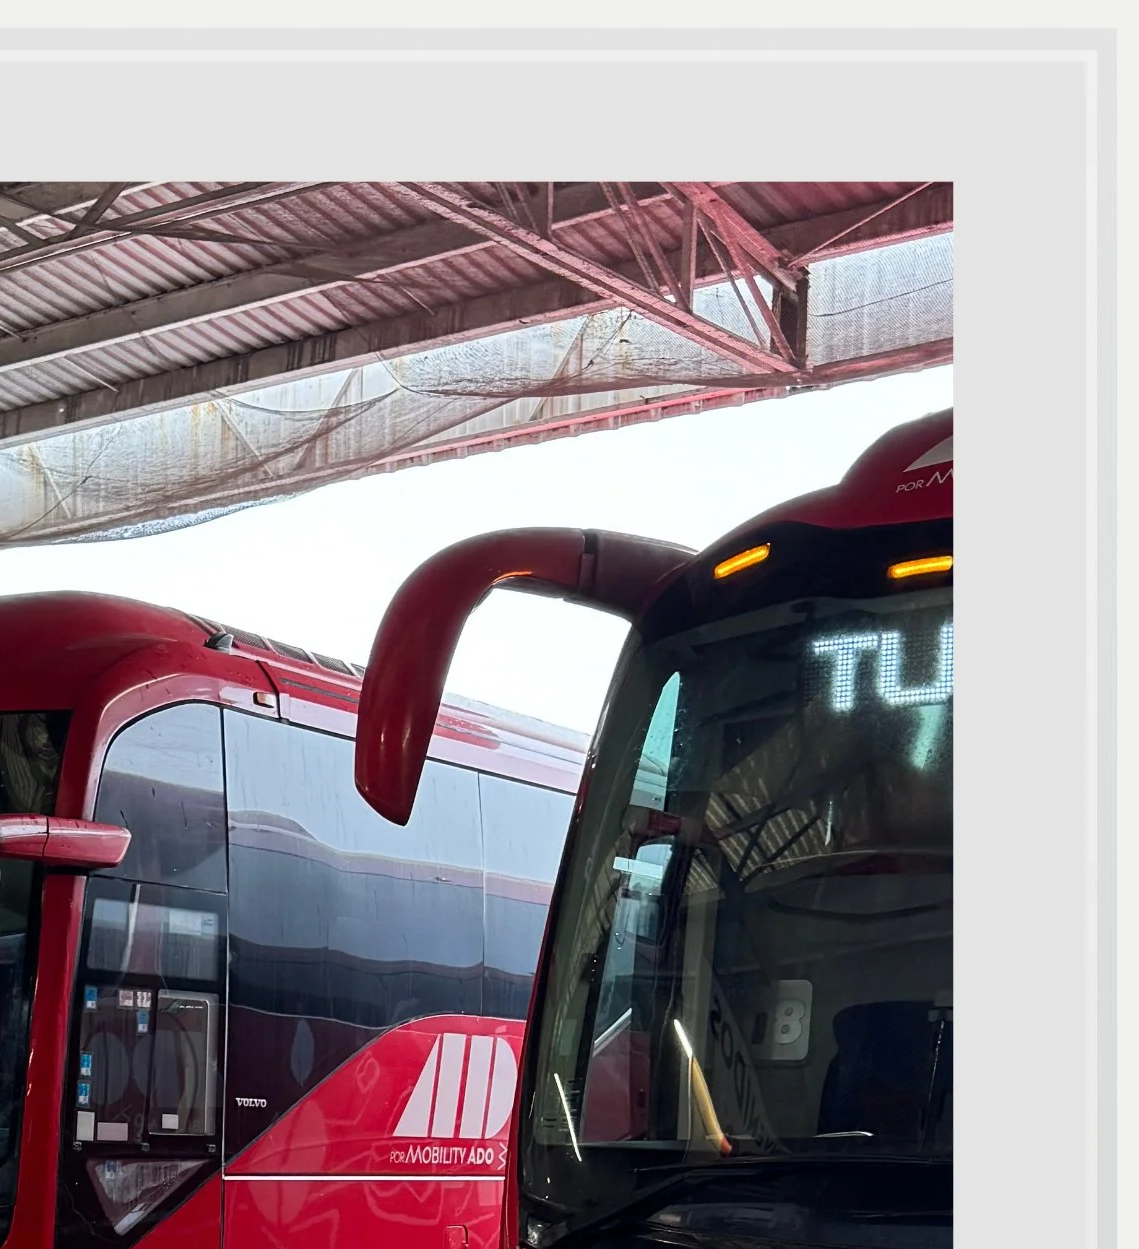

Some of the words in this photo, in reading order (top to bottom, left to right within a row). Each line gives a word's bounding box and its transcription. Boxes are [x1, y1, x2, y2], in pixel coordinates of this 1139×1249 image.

[895, 479, 924, 494] POR
[235, 1097, 267, 1108] VOLVO
[405, 1144, 466, 1164] MOBILITY
[467, 1147, 494, 1165] ADO
